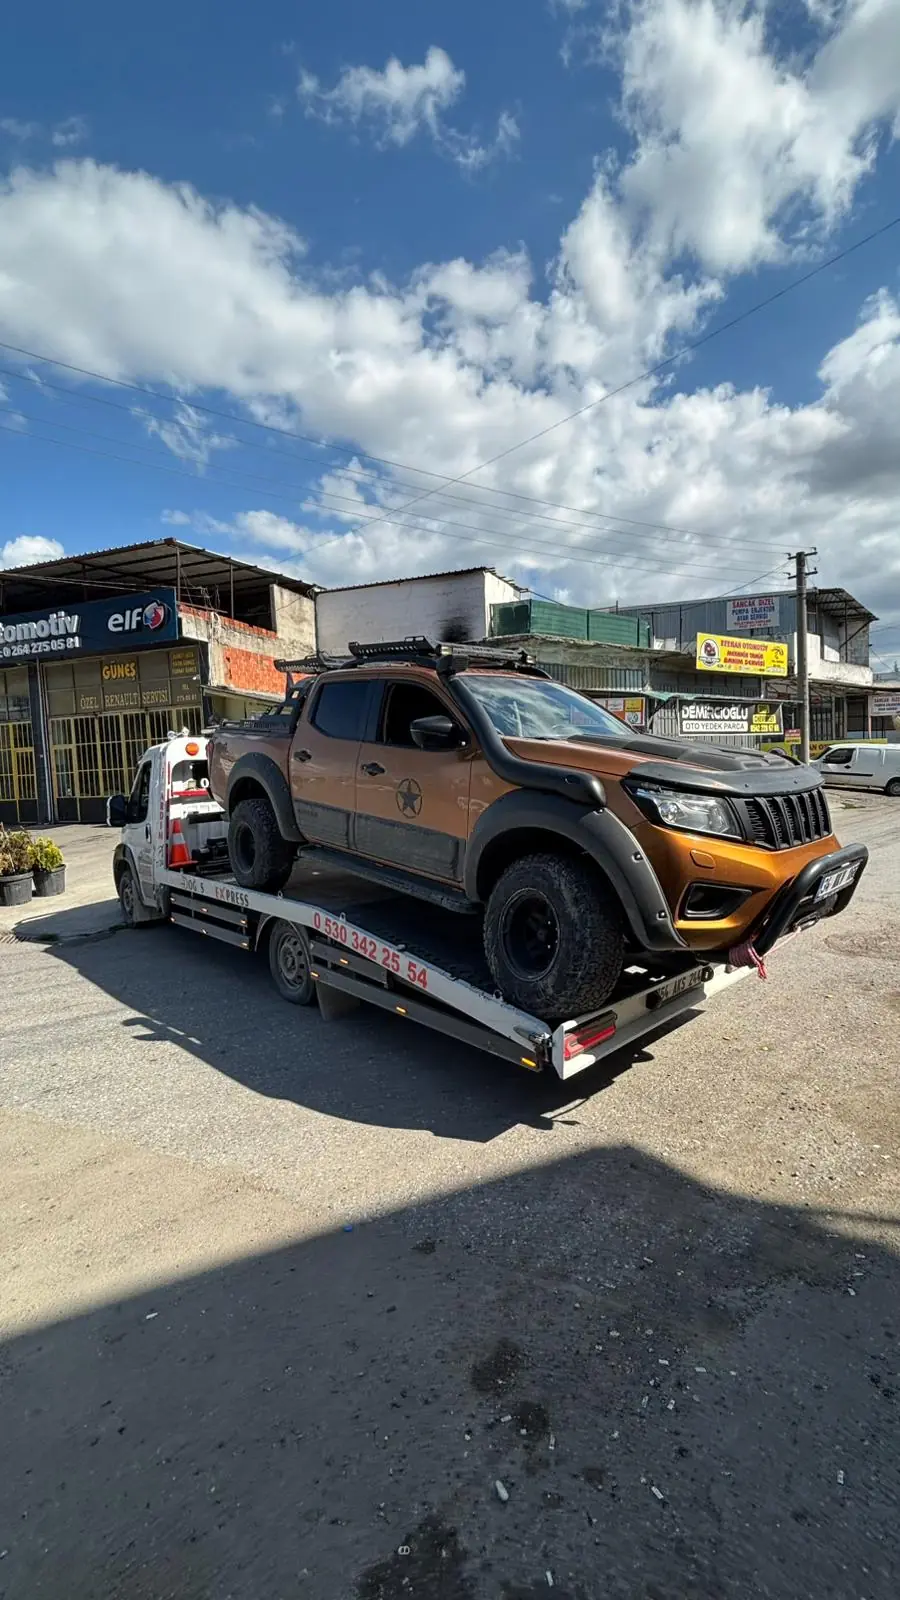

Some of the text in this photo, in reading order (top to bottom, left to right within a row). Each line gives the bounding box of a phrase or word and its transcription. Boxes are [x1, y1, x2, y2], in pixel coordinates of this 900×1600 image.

[108, 608, 142, 632] elf
[12, 643, 30, 656] 264
[31, 640, 50, 653] 275
[51, 639, 65, 651] 05
[66, 635, 80, 649] 81
[102, 660, 136, 681] GÜNEŞ
[81, 694, 99, 709] ÖZEL
[104, 692, 138, 707] RENAULT
[685, 722, 700, 730] OTO
[700, 722, 722, 730] YEDEK
[215, 887, 249, 906] EXPRESS
[313, 912, 428, 989] 0 530 342 25 54
